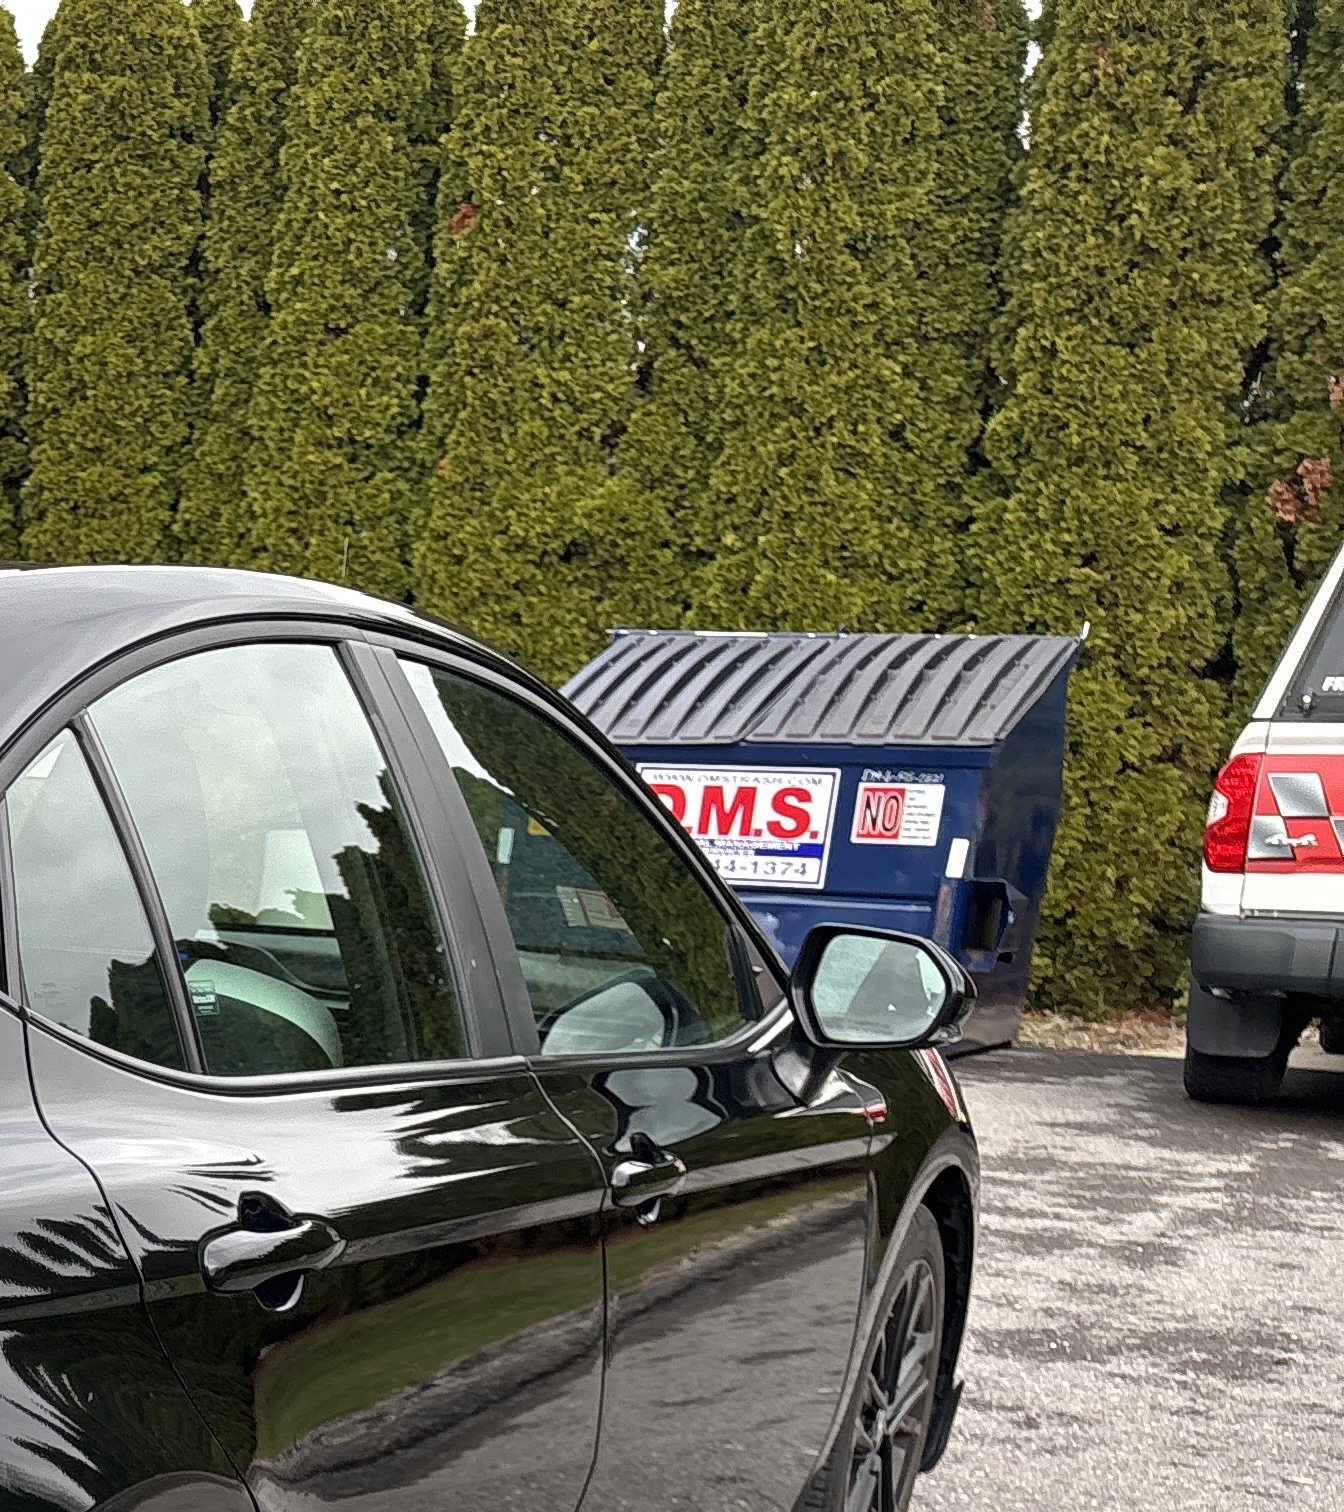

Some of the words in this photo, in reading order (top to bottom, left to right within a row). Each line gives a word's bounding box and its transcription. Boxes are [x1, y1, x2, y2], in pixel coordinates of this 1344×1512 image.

[649, 783, 820, 840] D.M.S.
[858, 790, 903, 837] NO
[713, 858, 808, 877] 44-1374
